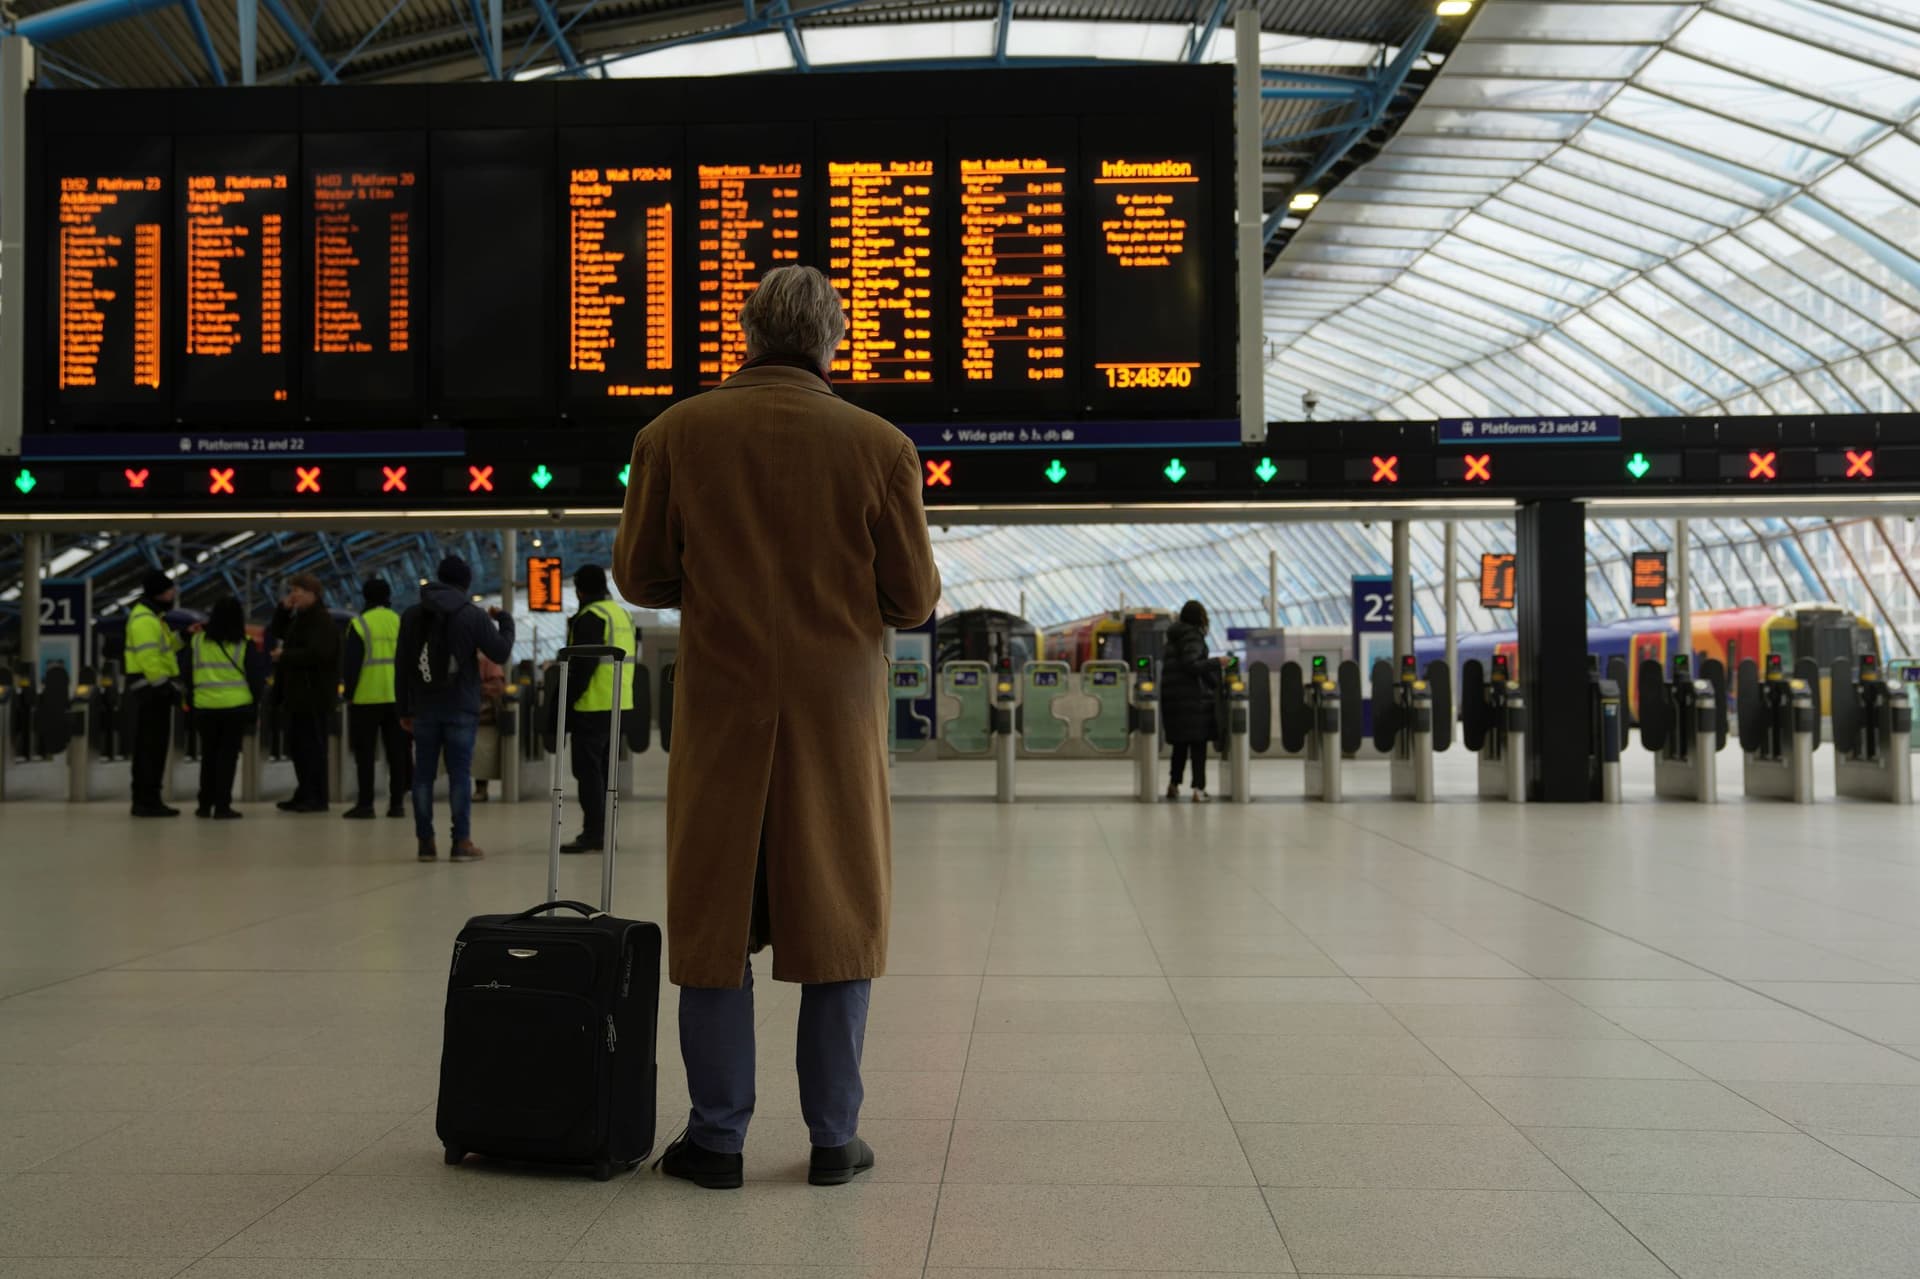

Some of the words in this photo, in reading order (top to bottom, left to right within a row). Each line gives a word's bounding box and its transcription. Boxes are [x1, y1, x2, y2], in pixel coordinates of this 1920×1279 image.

[1102, 159, 1192, 177] Information
[97, 177, 144, 191] Platform
[225, 176, 272, 189] Platform
[273, 175, 287, 189] 21
[352, 173, 398, 186] Platform
[399, 172, 415, 185] 20
[1105, 367, 1192, 388] 13:48:40
[1481, 422, 1537, 434] Platforms
[1539, 421, 1554, 433] 23
[1557, 421, 1579, 433] and
[1580, 420, 1597, 433] 24
[958, 430, 987, 441] Wide
[989, 431, 1015, 443] gate
[198, 439, 250, 451] Platforms
[252, 438, 265, 450] 21
[268, 438, 287, 450] and
[289, 438, 305, 450] 22
[40, 597, 76, 626] 21
